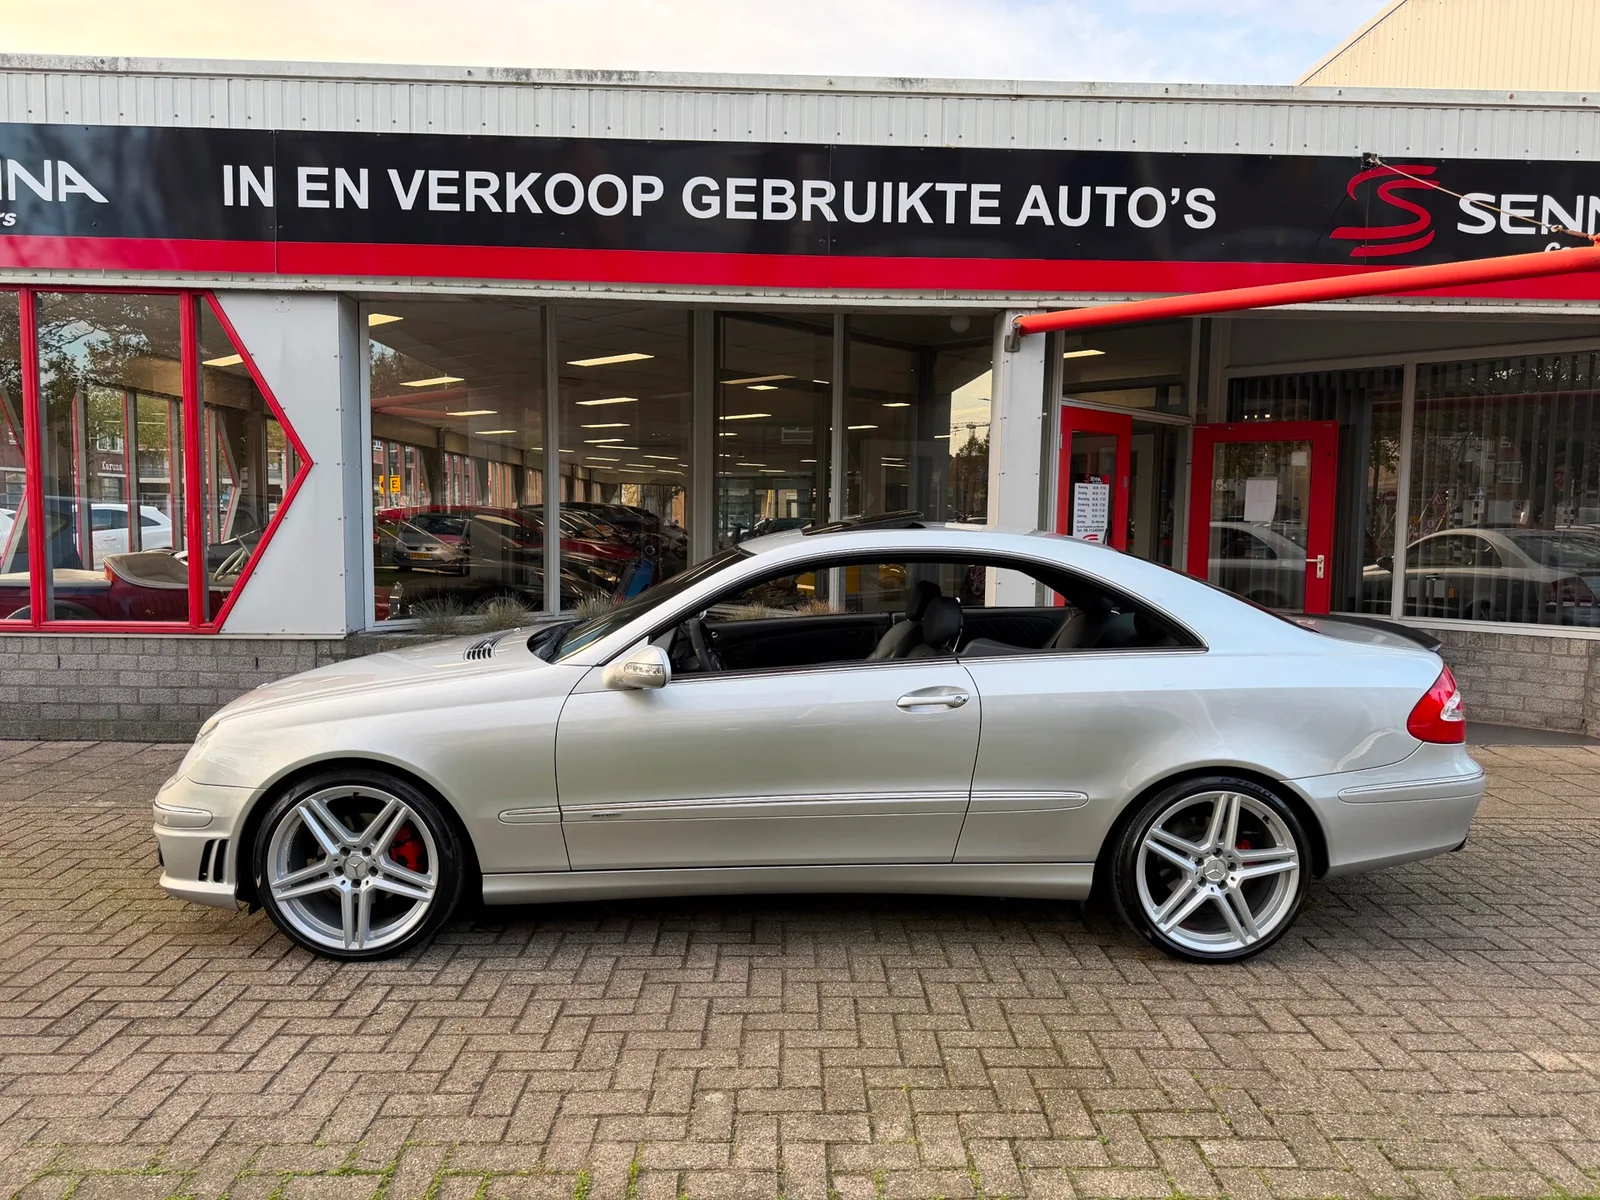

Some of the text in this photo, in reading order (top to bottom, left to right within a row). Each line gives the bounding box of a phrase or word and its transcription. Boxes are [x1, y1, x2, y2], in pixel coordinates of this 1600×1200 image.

[0, 159, 109, 203] NA
[223, 164, 1217, 229] IN EN VERKOOP GEBRUIKTE AUTO’S
